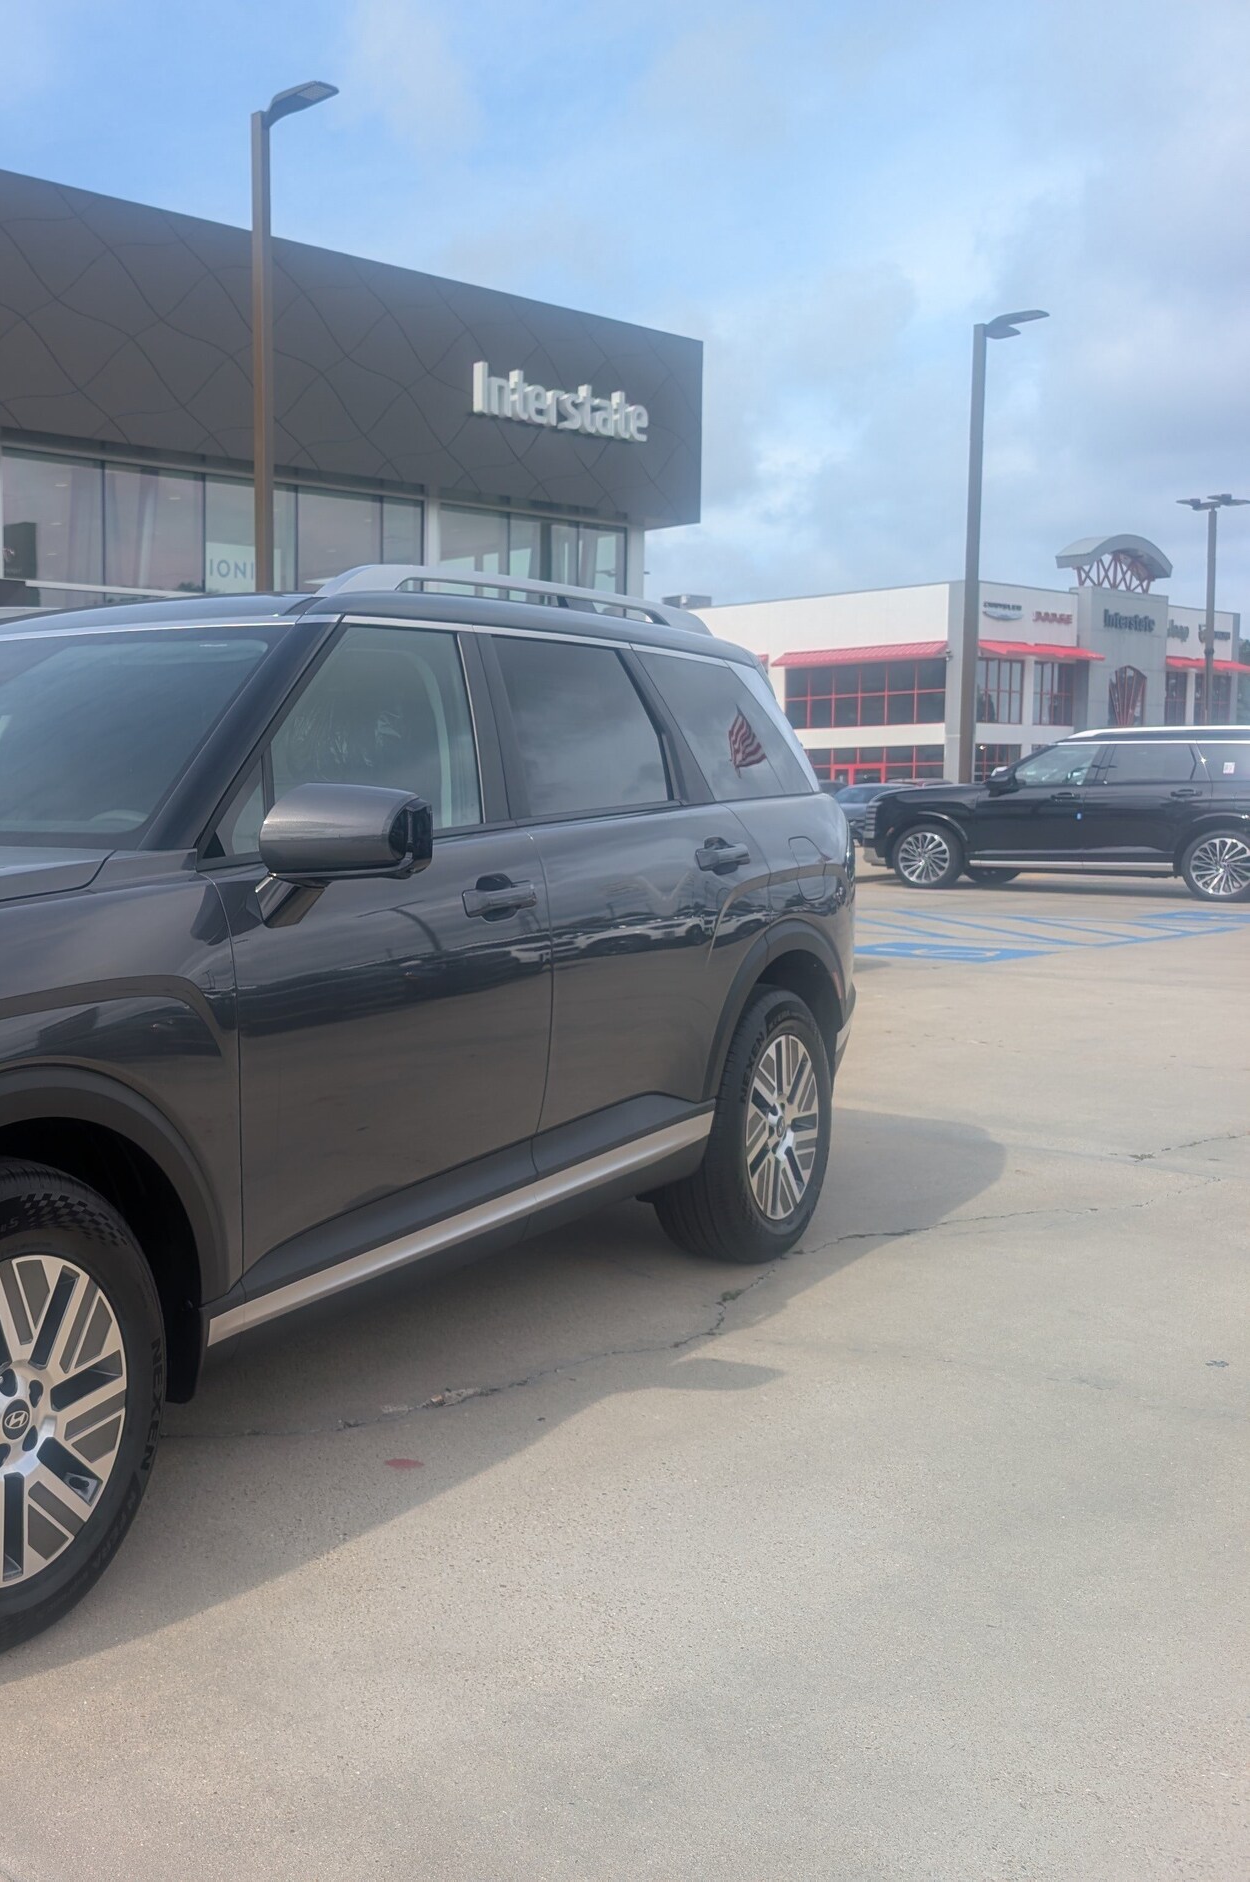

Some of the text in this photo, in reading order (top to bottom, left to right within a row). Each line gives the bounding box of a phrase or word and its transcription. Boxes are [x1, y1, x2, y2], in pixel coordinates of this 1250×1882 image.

[473, 361, 648, 442] Interstate
[210, 558, 255, 580] IONI
[1103, 609, 1155, 632] Interstate
[140, 1336, 163, 1472] NEXEN
